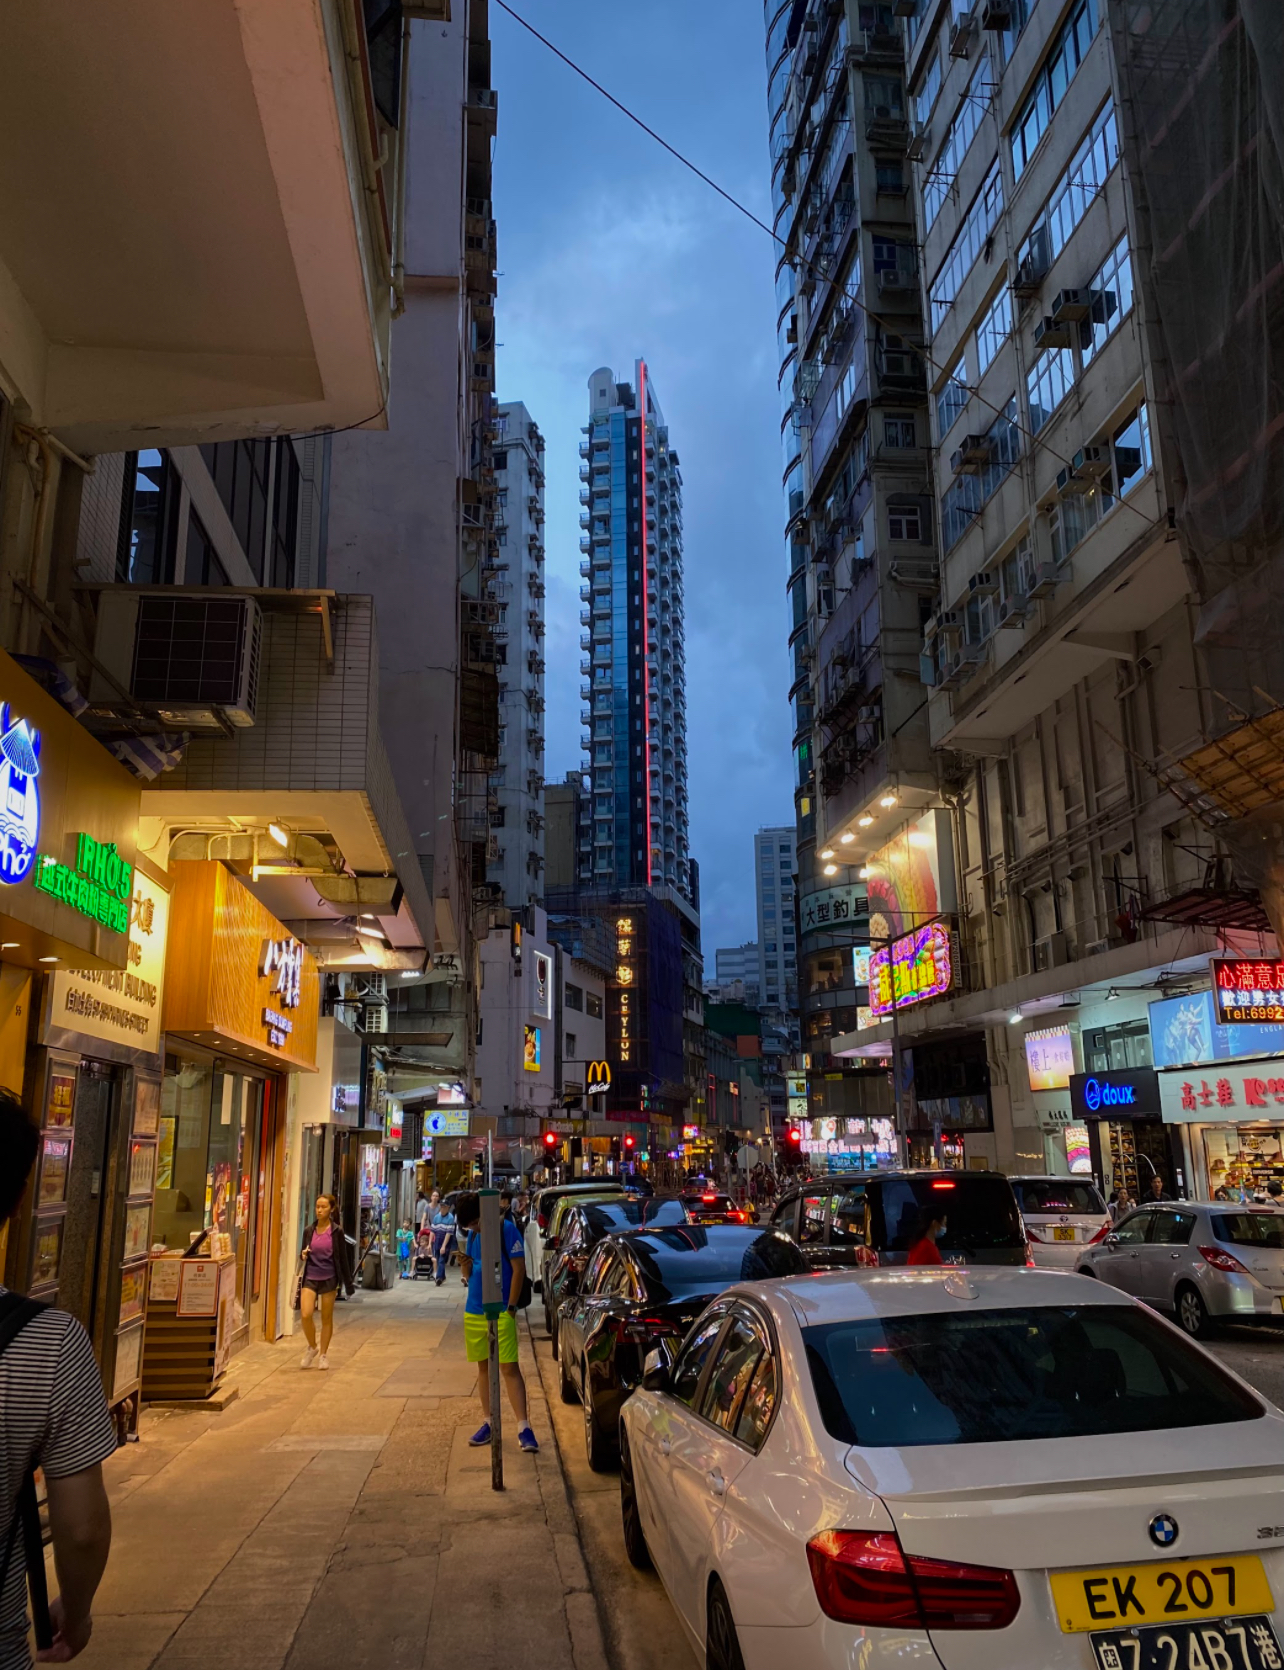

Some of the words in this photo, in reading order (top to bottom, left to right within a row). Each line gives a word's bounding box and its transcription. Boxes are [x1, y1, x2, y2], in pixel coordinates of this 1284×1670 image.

[1221, 989, 1284, 1007] 歡迎男女
[620, 994, 630, 1061] CEYLON
[1102, 1082, 1135, 1105] doux
[1083, 1574, 1146, 1621] EK
[1157, 1565, 1236, 1614] 207
